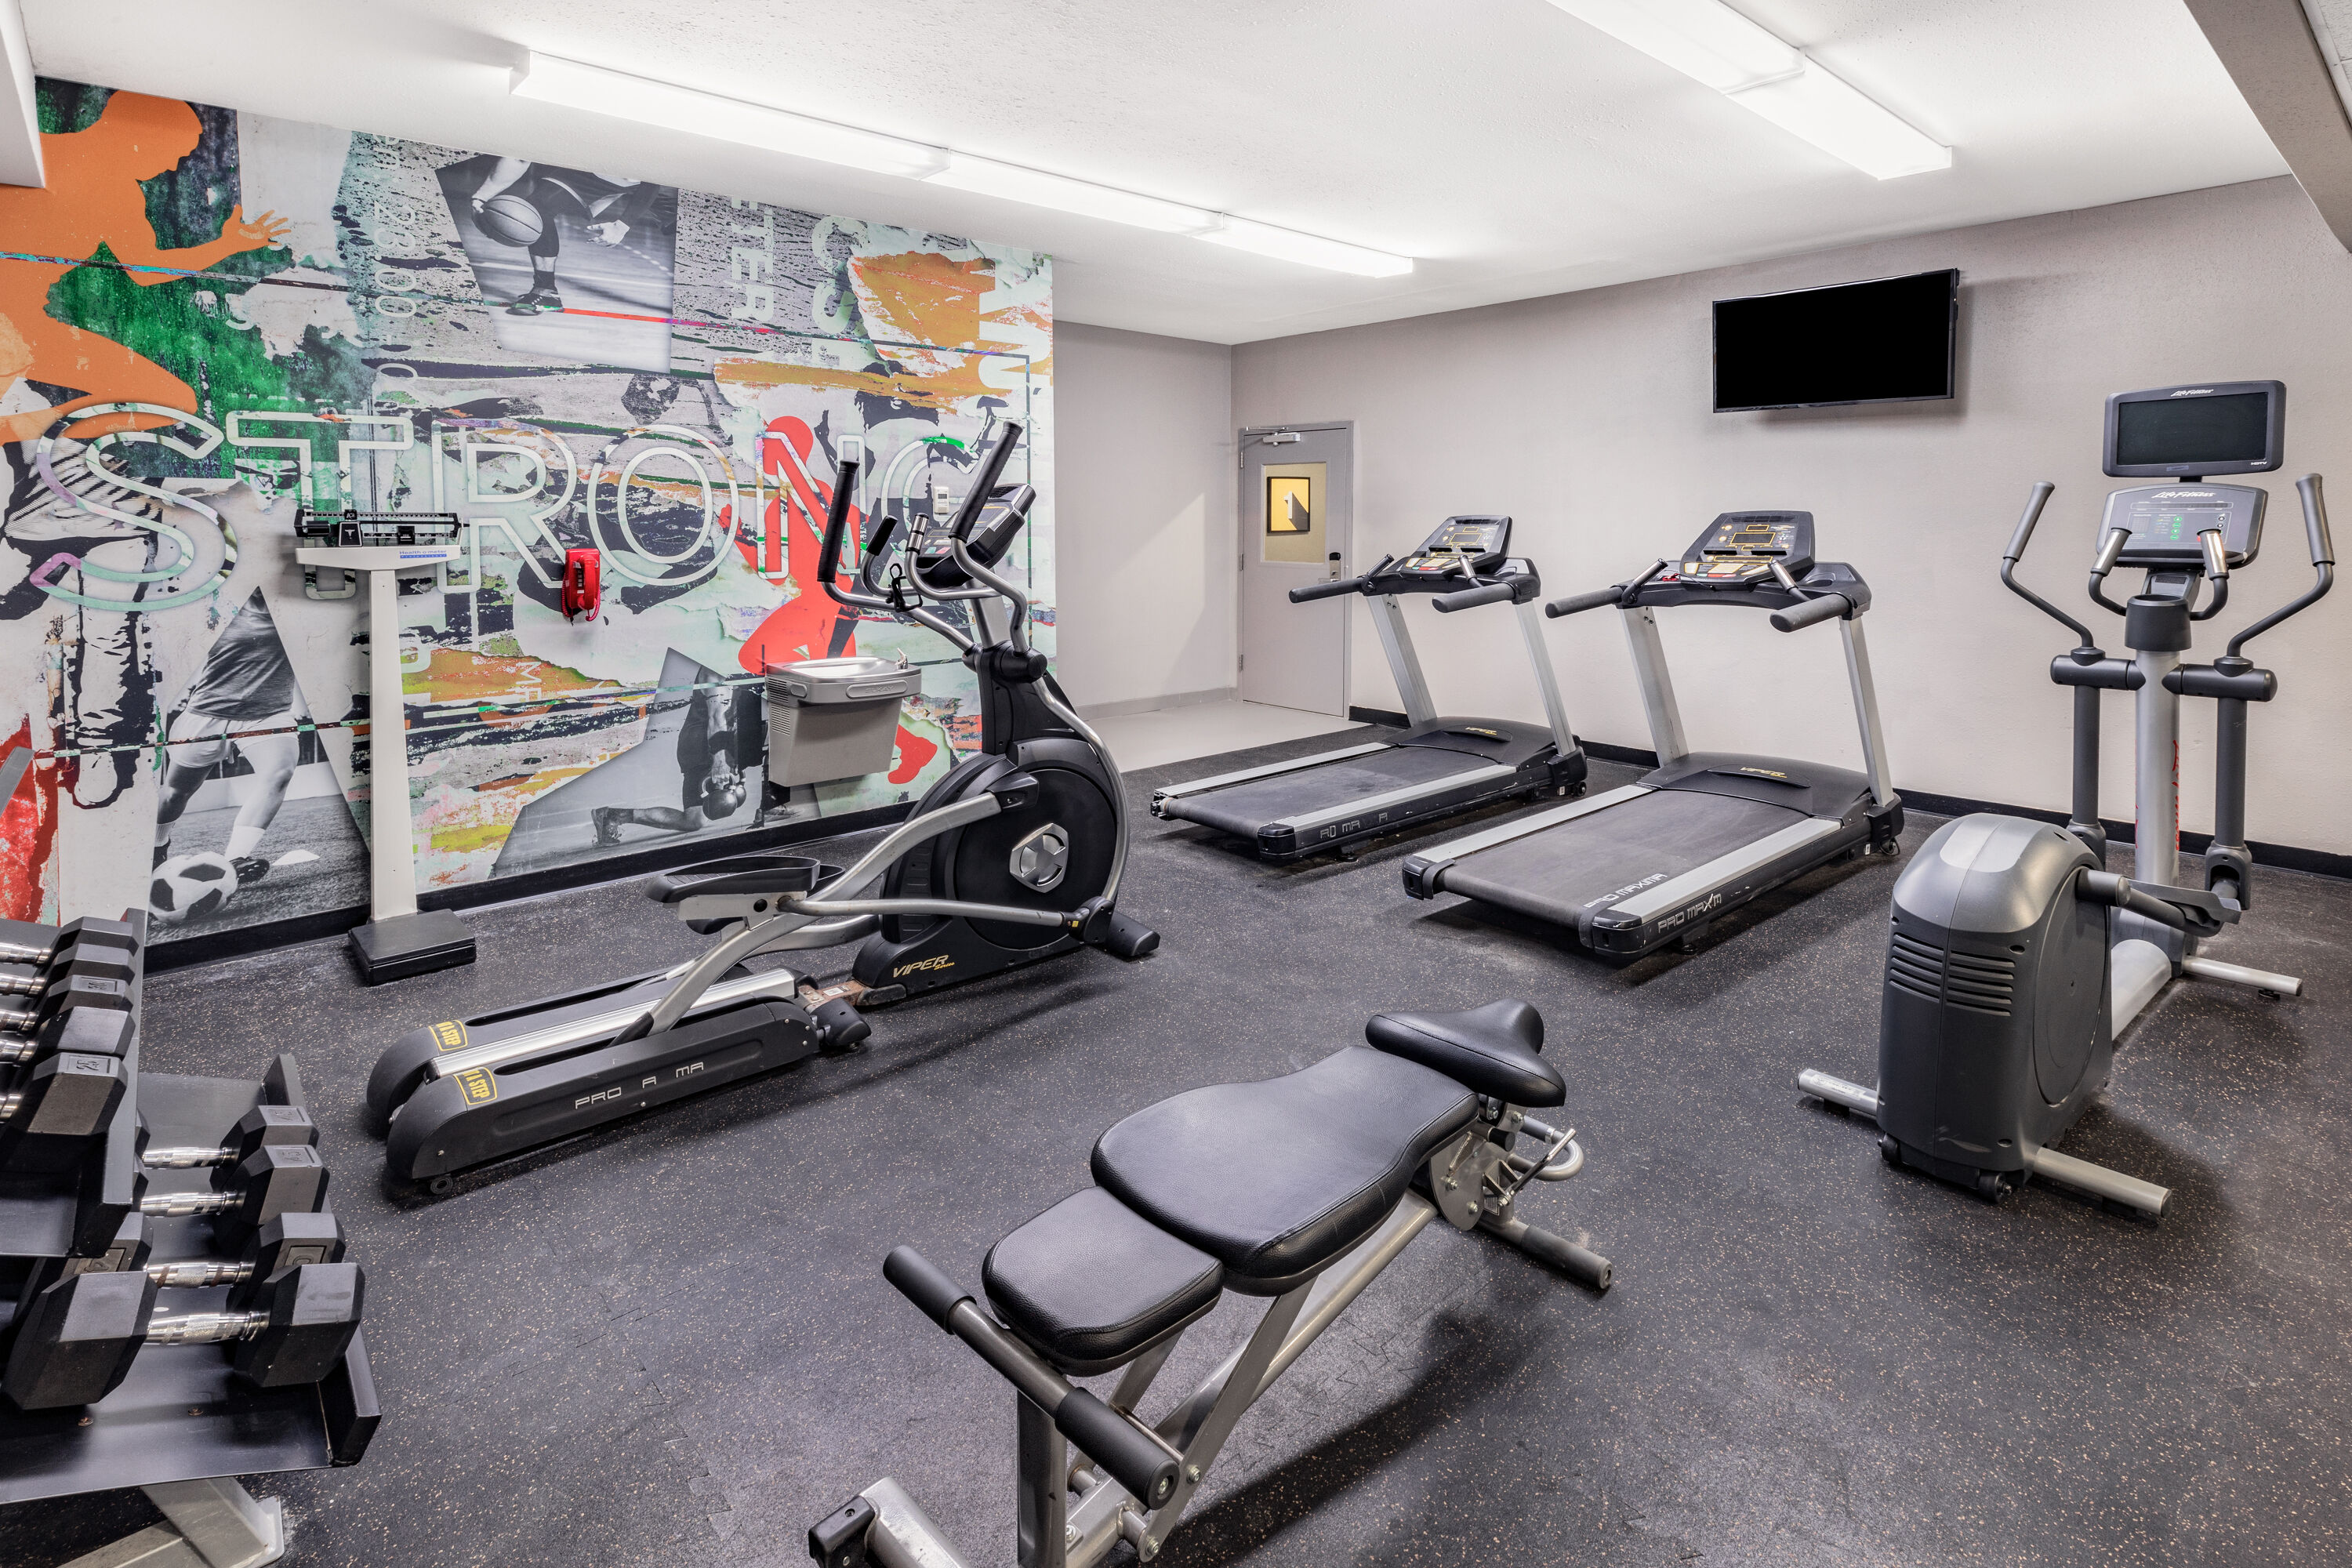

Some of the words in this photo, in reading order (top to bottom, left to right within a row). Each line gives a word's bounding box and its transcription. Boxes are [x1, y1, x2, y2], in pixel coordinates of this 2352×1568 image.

[731, 198, 774, 322] TER
[30, 402, 983, 612] STRONG
[1283, 491, 1293, 519] 1
[1658, 913, 1685, 934] PRO
[892, 954, 949, 978] VIPER
[575, 1087, 622, 1109] PRO
